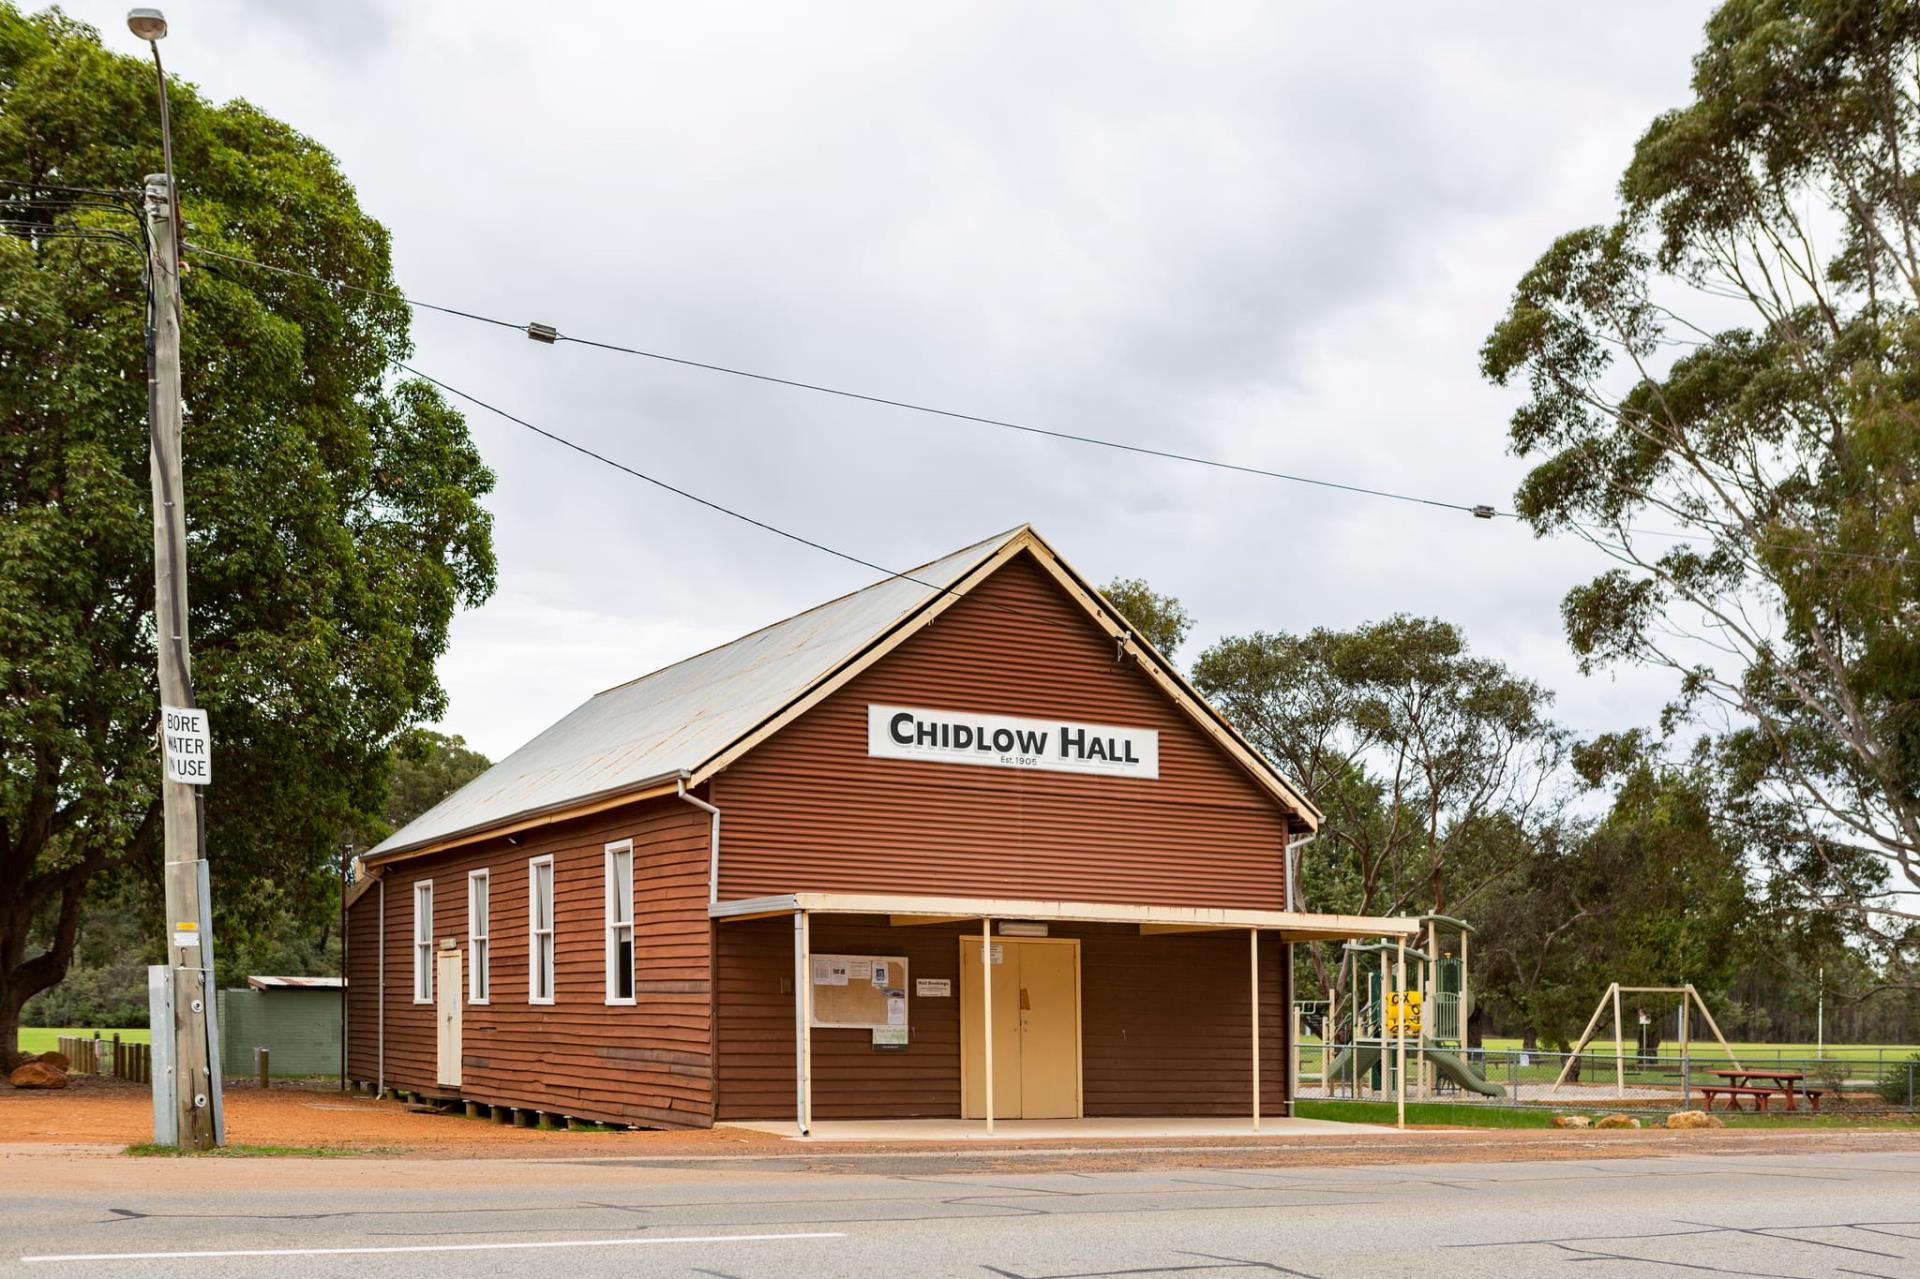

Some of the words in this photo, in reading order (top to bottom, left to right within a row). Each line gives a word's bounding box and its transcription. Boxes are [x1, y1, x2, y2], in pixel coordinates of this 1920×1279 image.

[167, 713, 200, 733] BORE
[166, 734, 205, 755] WATER
[890, 711, 1048, 756] CHIDLOW
[1059, 726, 1140, 764] HALL
[177, 759, 207, 777] USE
